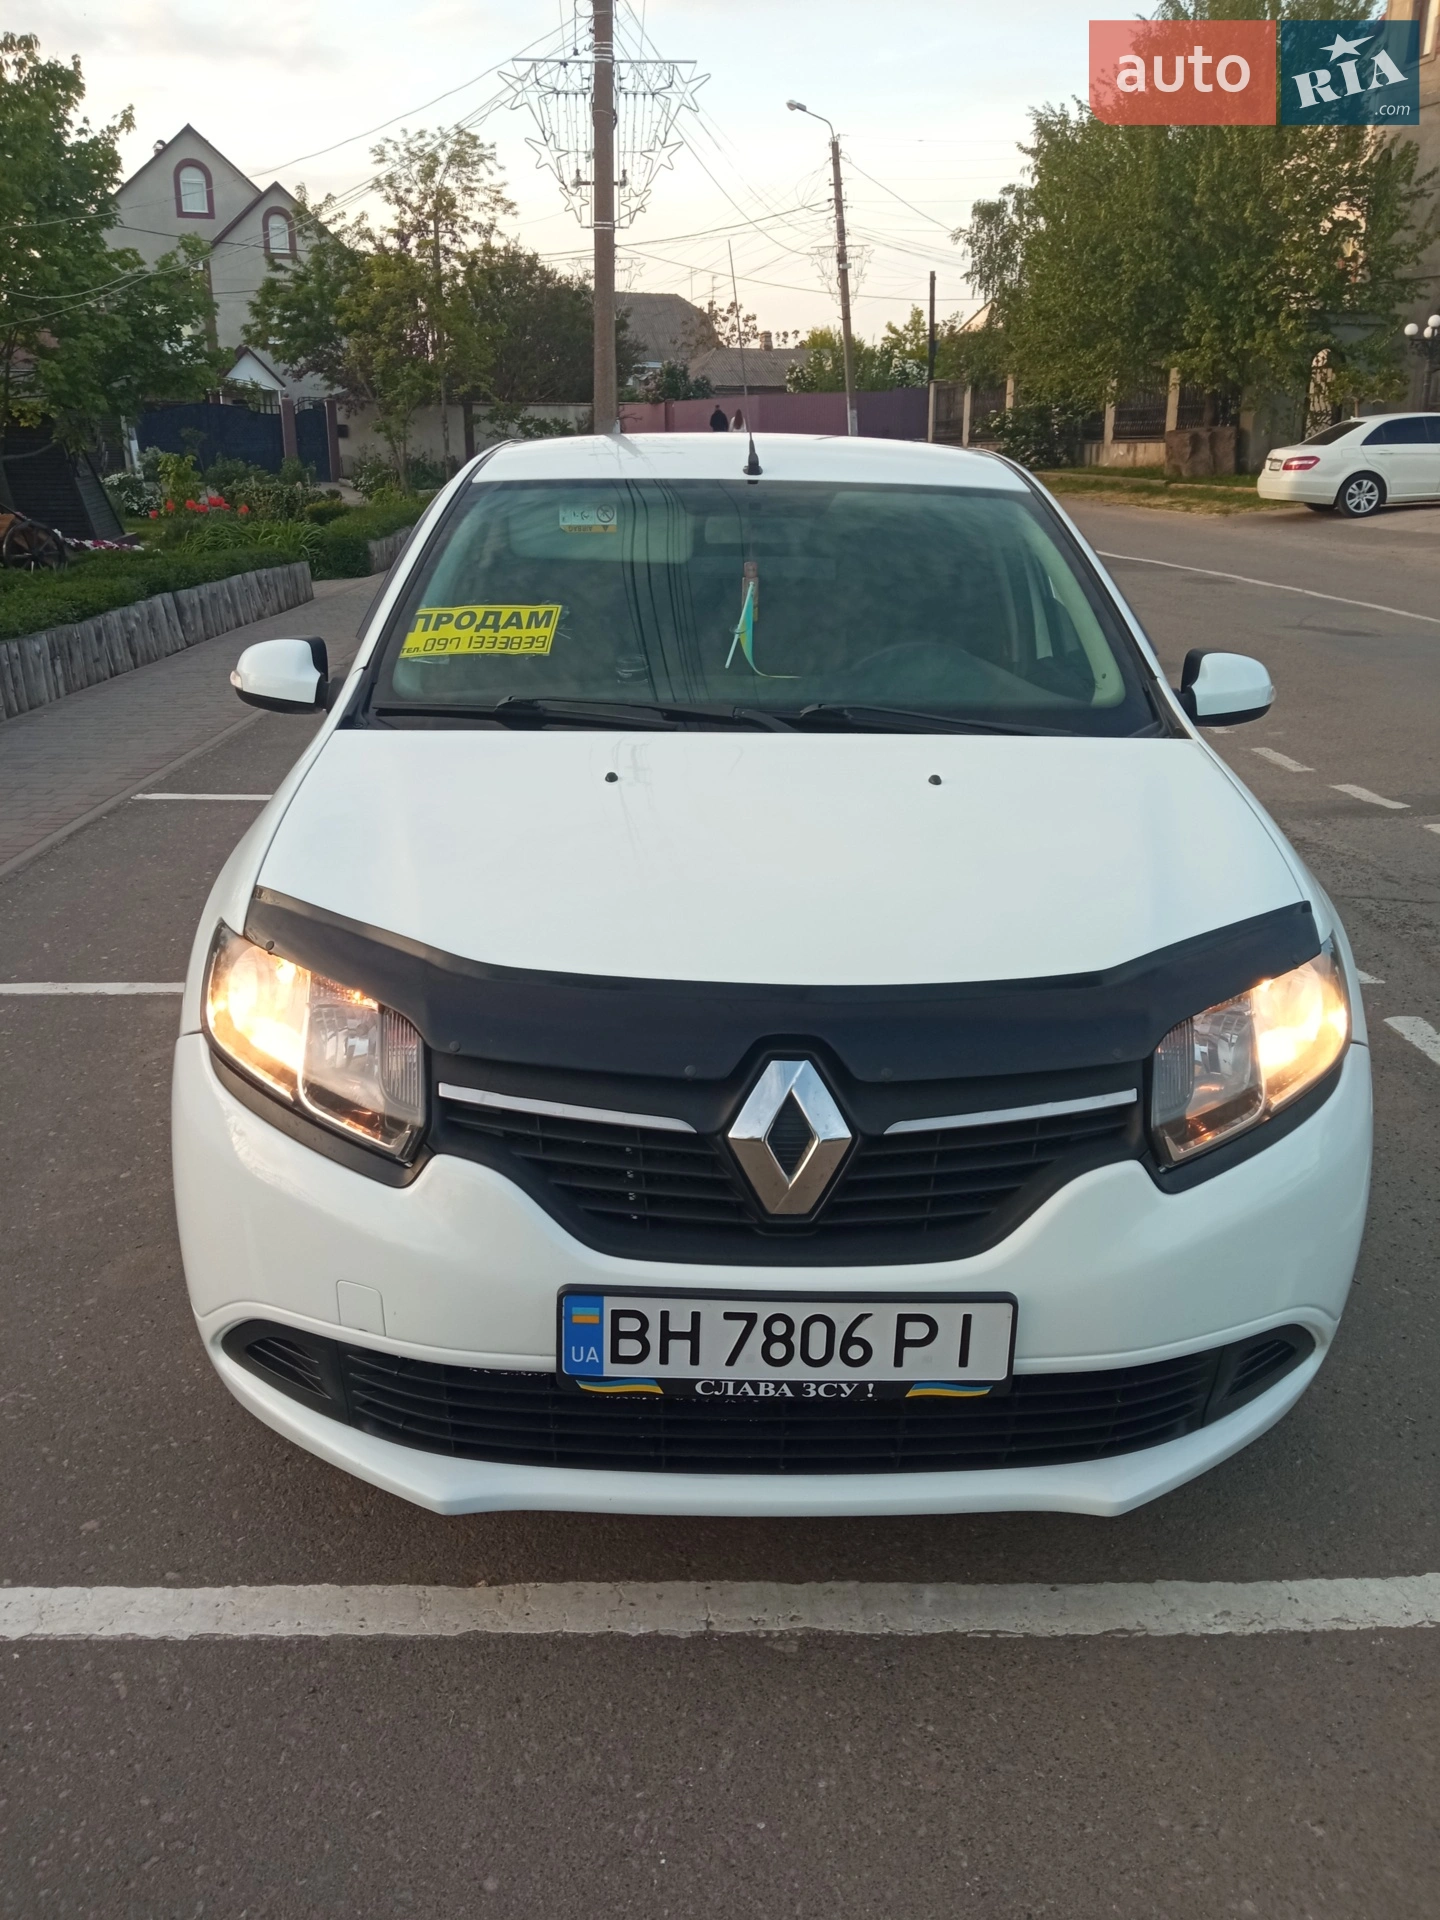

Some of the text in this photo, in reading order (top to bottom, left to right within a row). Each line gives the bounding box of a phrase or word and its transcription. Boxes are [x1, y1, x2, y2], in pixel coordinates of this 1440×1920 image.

[408, 611, 554, 633] ПРОДАМ
[423, 637, 461, 652] 097
[467, 635, 548, 650] 1333839
[609, 1309, 701, 1366] BH
[723, 1311, 874, 1368] 7806
[571, 1346, 600, 1363] UA
[694, 1380, 795, 1397] СЛАВА
[802, 1382, 858, 1398] ЗСУ
